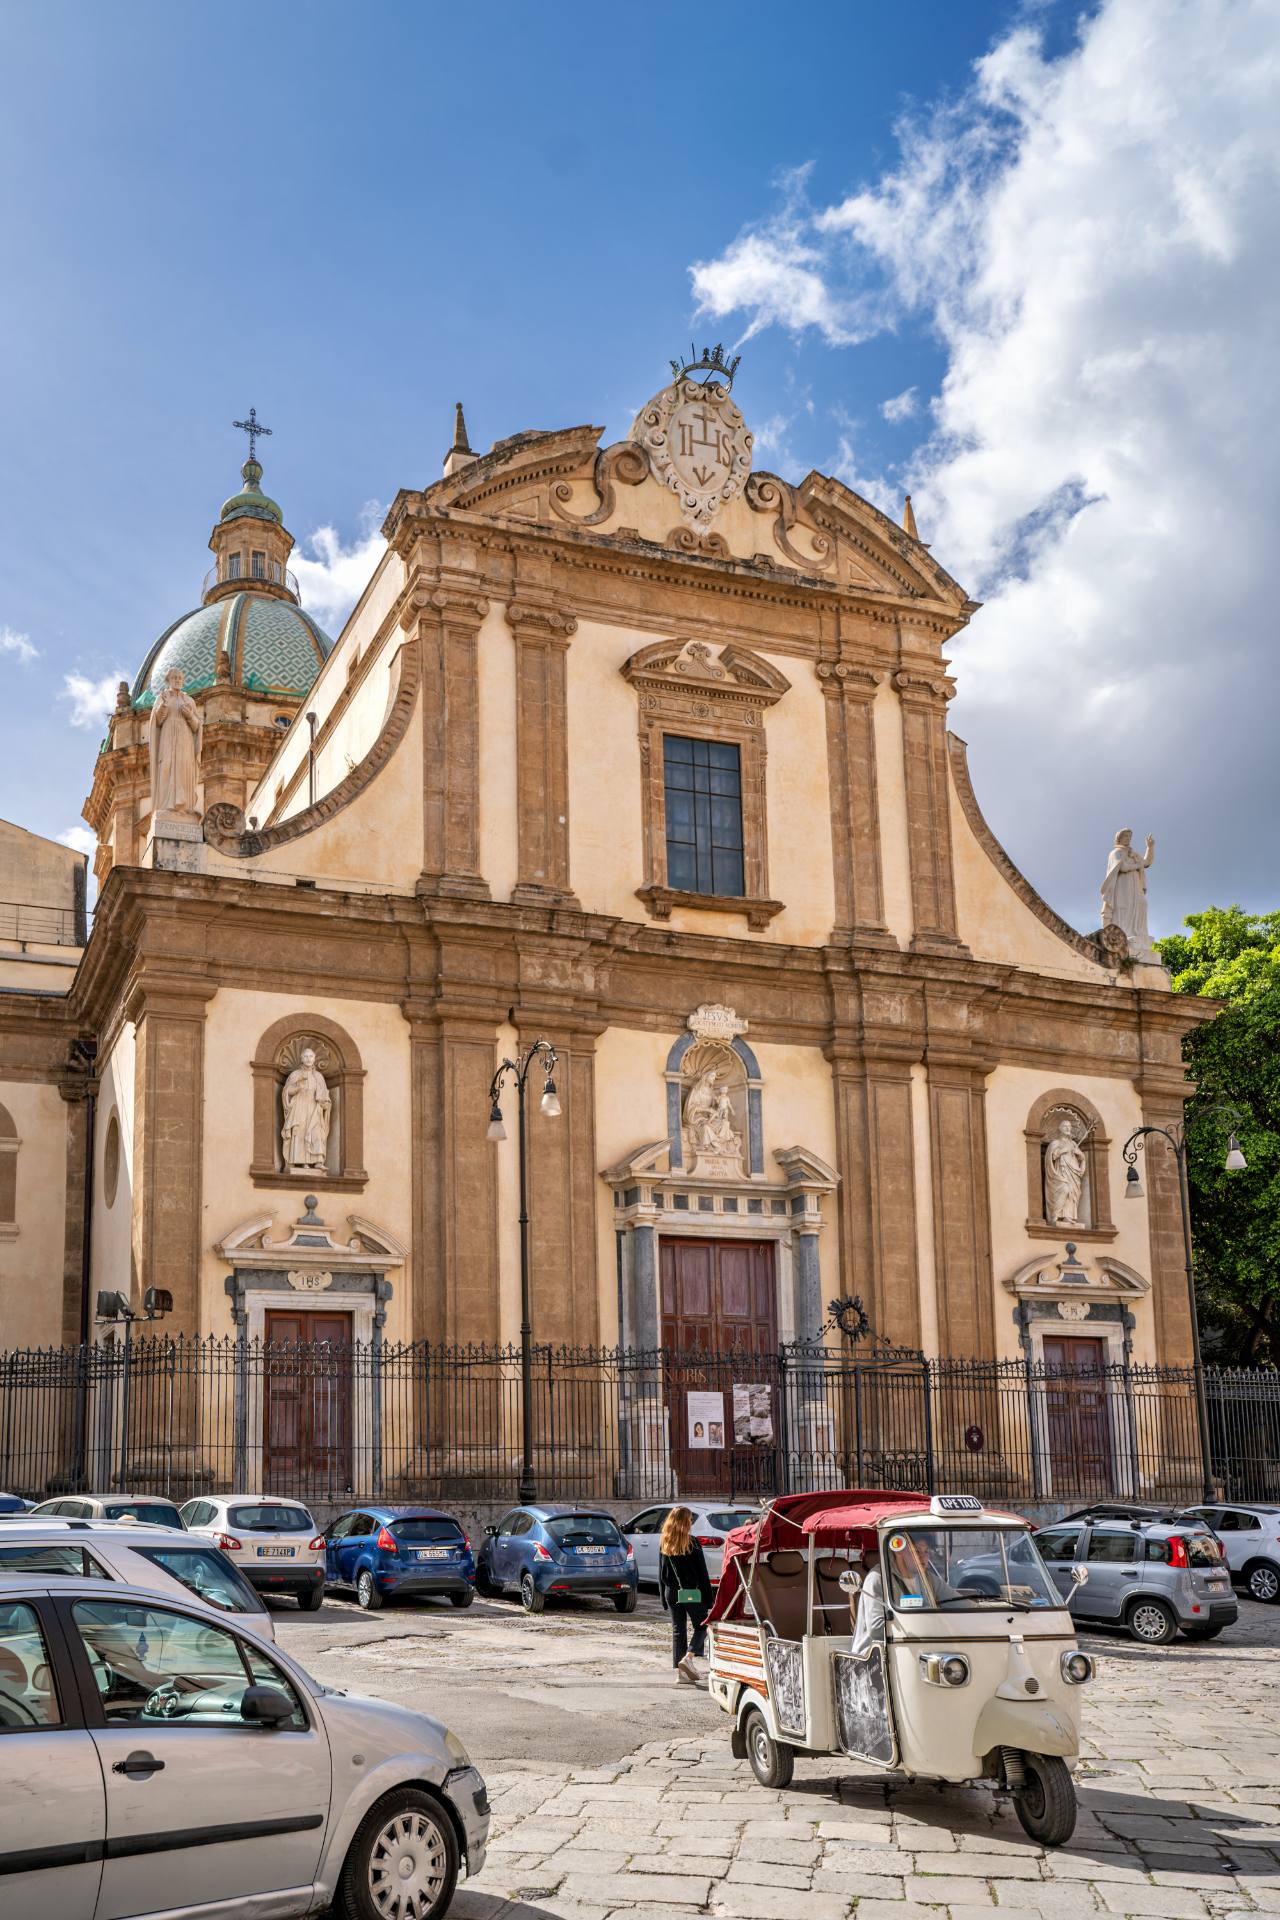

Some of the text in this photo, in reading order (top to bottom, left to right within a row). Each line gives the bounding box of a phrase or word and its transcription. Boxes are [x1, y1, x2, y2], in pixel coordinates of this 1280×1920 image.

[678, 407, 732, 468] IHS
[302, 1275, 320, 1287] IHS
[941, 1497, 980, 1509] APE TAXI
